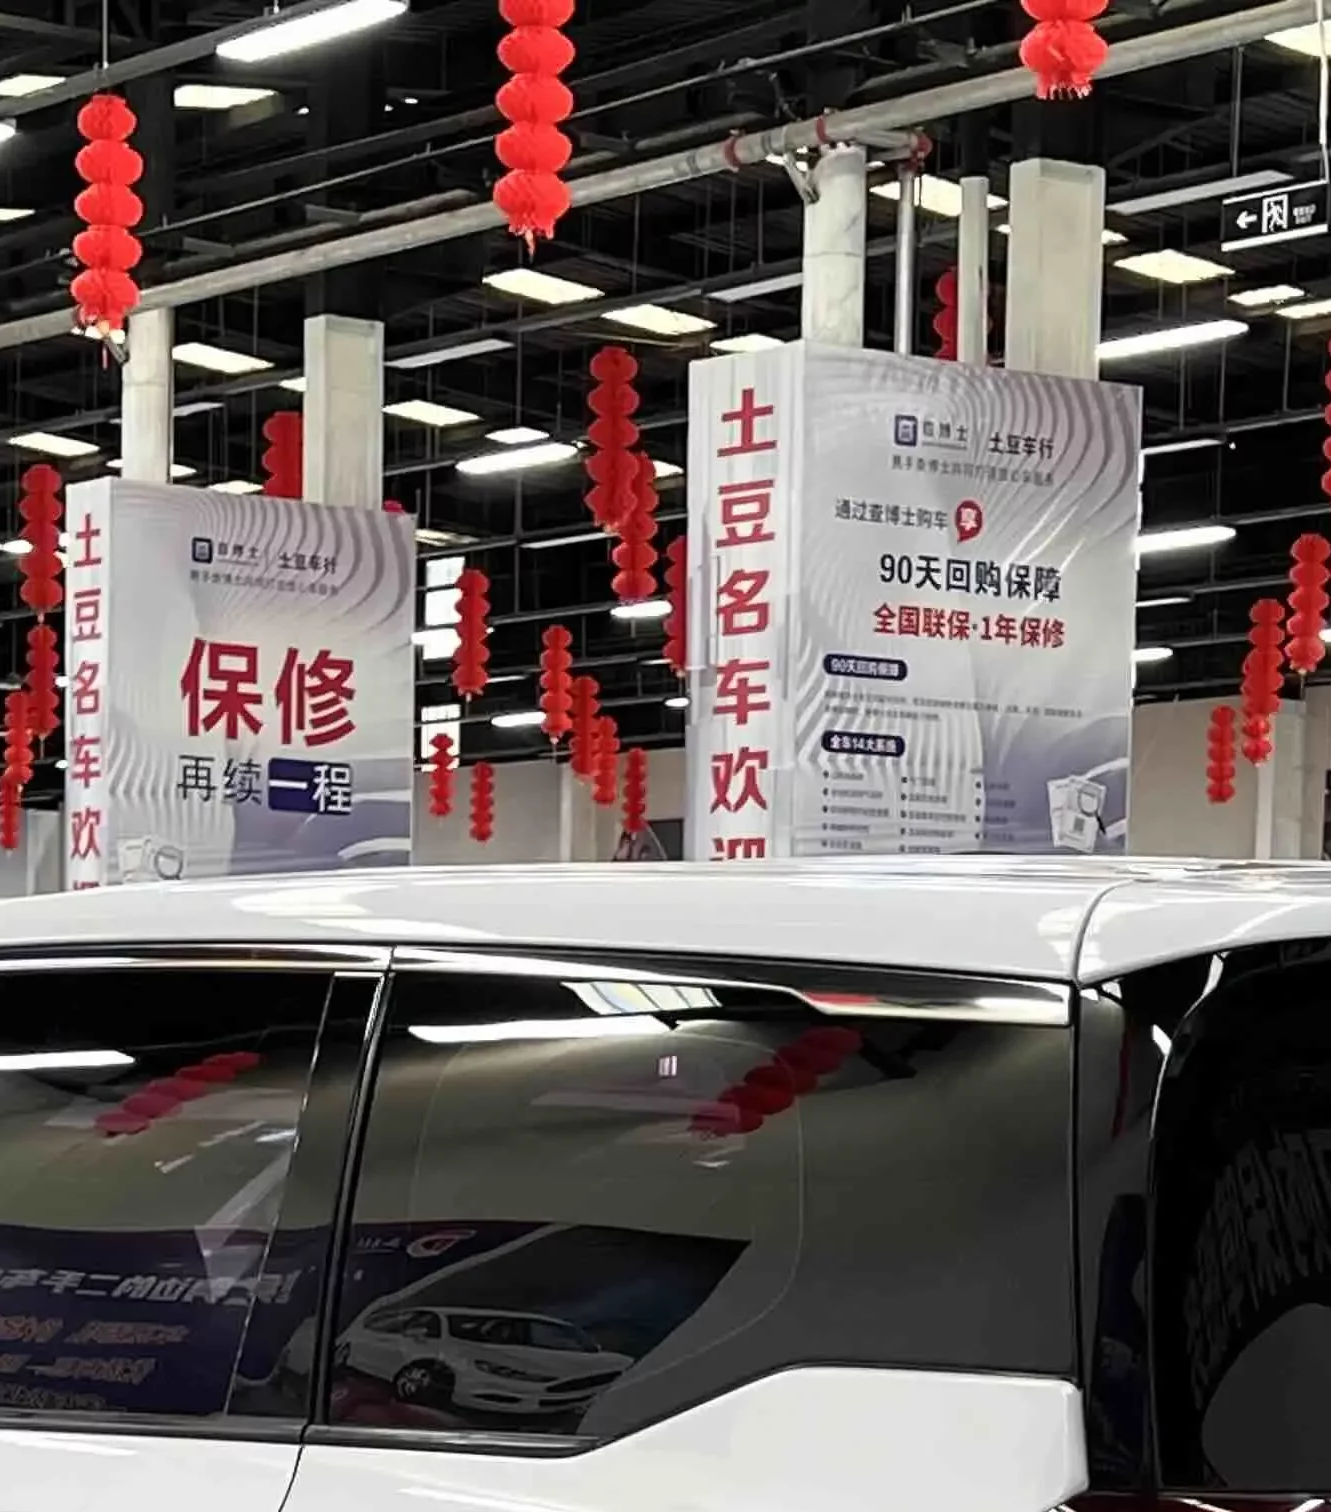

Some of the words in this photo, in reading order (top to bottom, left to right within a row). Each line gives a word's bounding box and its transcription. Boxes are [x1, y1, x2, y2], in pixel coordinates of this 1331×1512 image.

[988, 431, 1054, 460] 土豆车行
[880, 553, 1062, 603] 90天回购保障
[70, 512, 103, 890] 土豆名车欢
[180, 638, 358, 747] 保修
[177, 755, 353, 814] 再续一程
